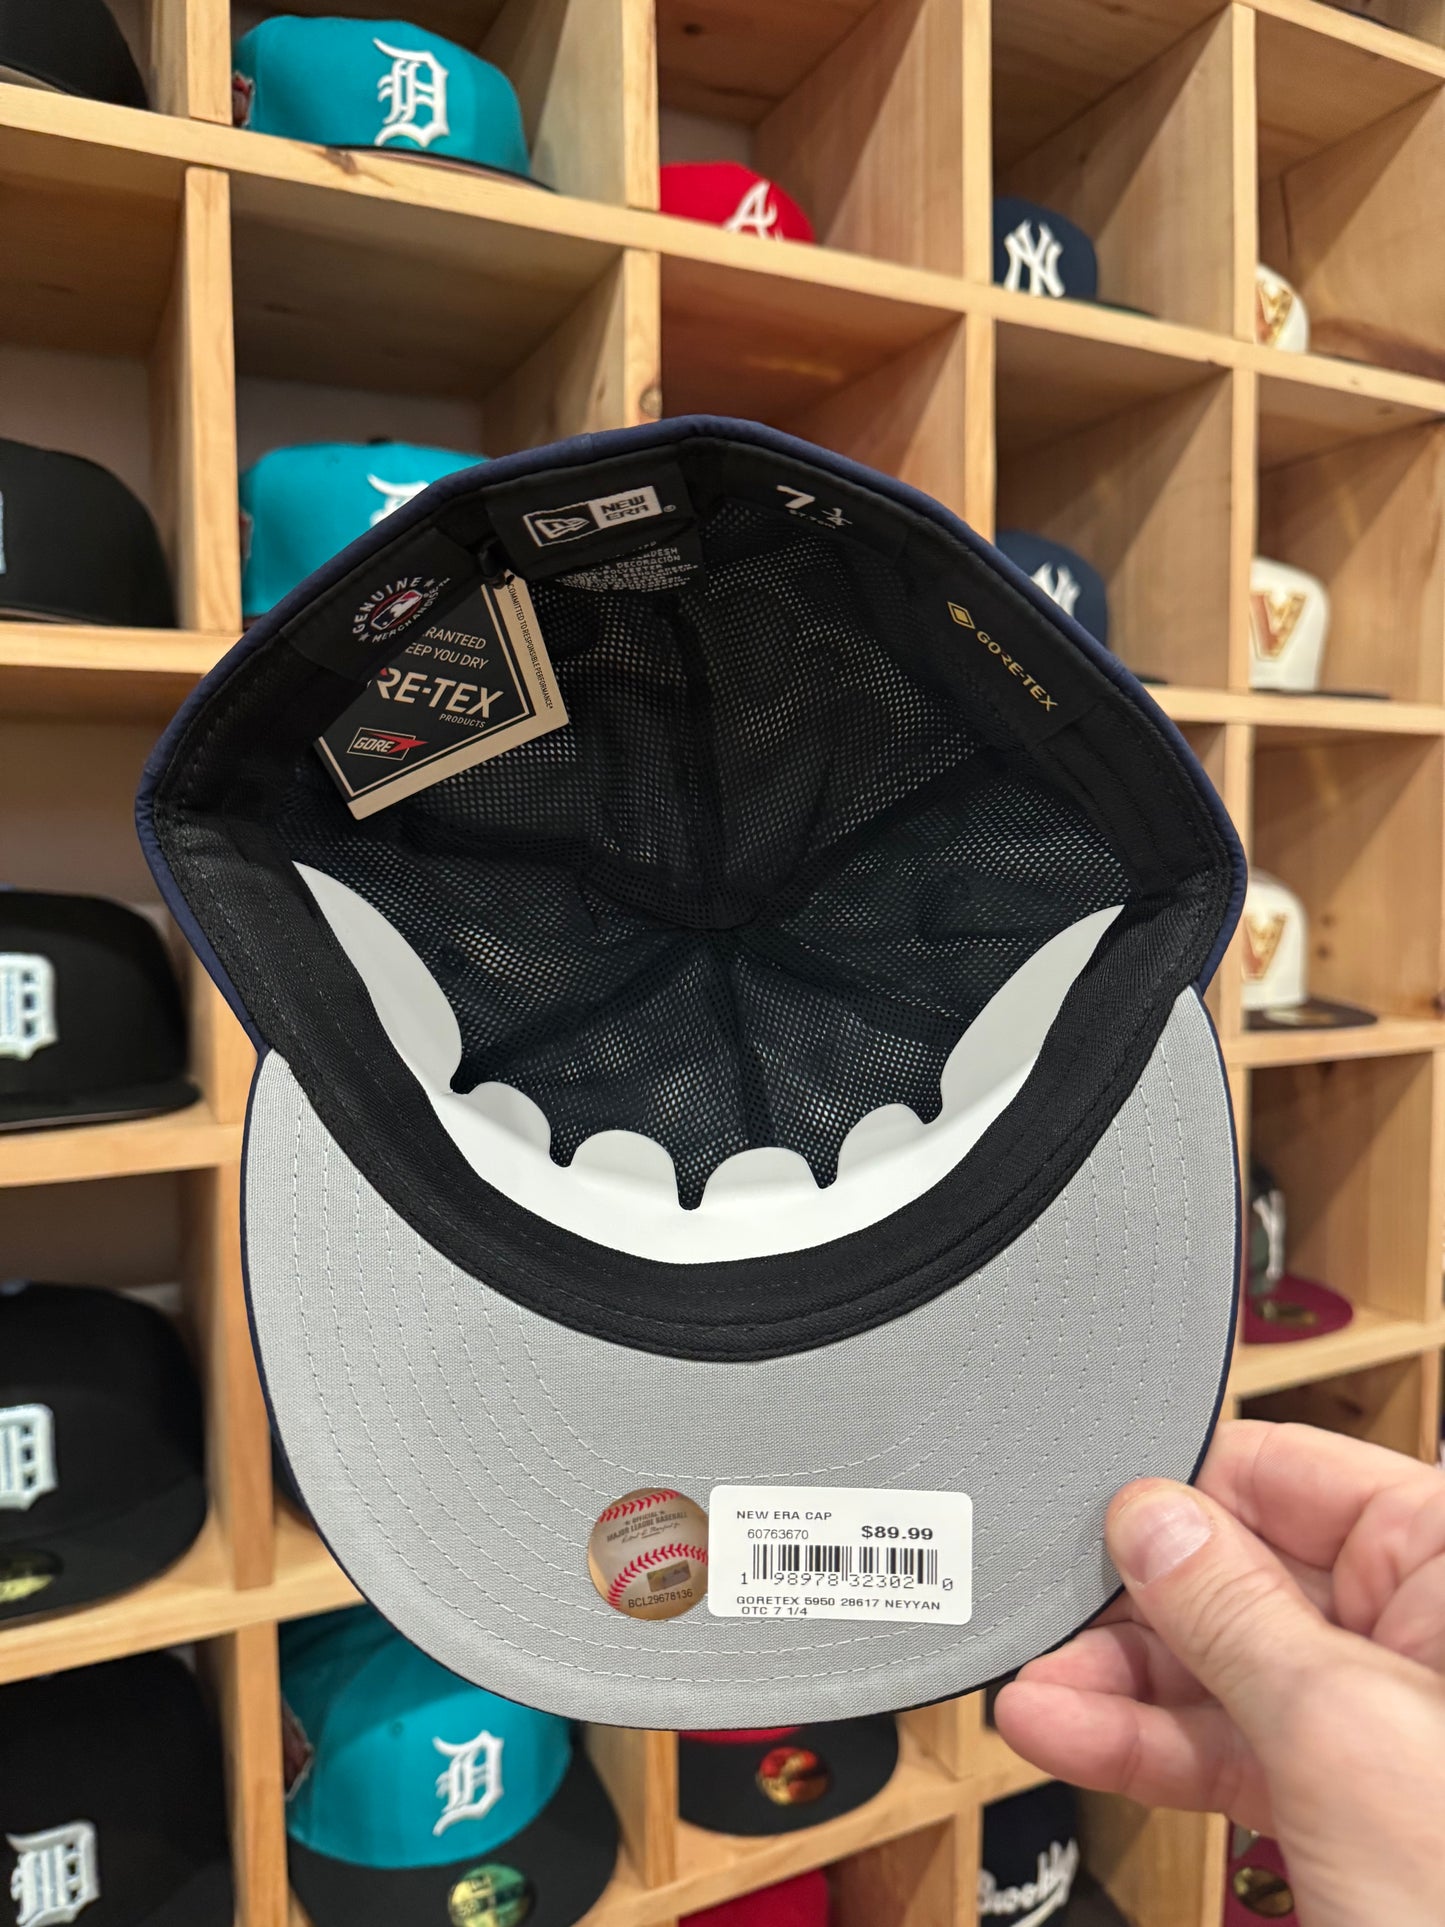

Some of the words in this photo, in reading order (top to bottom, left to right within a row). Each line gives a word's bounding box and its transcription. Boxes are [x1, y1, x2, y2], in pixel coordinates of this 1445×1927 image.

[600, 495, 645, 514] NEW
[776, 485, 815, 509] 7
[605, 505, 649, 522] ERA
[352, 577, 422, 634] GENUINE
[507, 583, 525, 621] COMMITTED
[520, 620, 528, 629] TO
[423, 626, 486, 650] RANTEED
[522, 628, 540, 667] RESPONSIBLE
[433, 648, 460, 665] YOU
[460, 654, 489, 670] DRY
[976, 630, 1058, 712] GORE-TEX
[374, 667, 504, 719] RE-TEX
[439, 713, 486, 729] PRODUCTS
[353, 736, 394, 753] GORE
[736, 1510, 769, 1520] NEW
[773, 1511, 800, 1520] ERA
[805, 1511, 832, 1521] CAP
[607, 1527, 630, 1543] MAJOR
[631, 1519, 654, 1533] LEAGUE
[656, 1511, 688, 1524] BASEBALL
[747, 1528, 809, 1540] 60763670
[861, 1525, 933, 1540] $89.99
[628, 1588, 693, 1608] BCL29678136
[736, 1595, 800, 1605] GORETEX
[804, 1597, 835, 1606] 5950
[840, 1597, 880, 1607] 28617
[885, 1599, 940, 1610] NEYYAN
[741, 1606, 768, 1615] OTC
[773, 1606, 782, 1615] 7
[787, 1606, 808, 1616] 1/4
